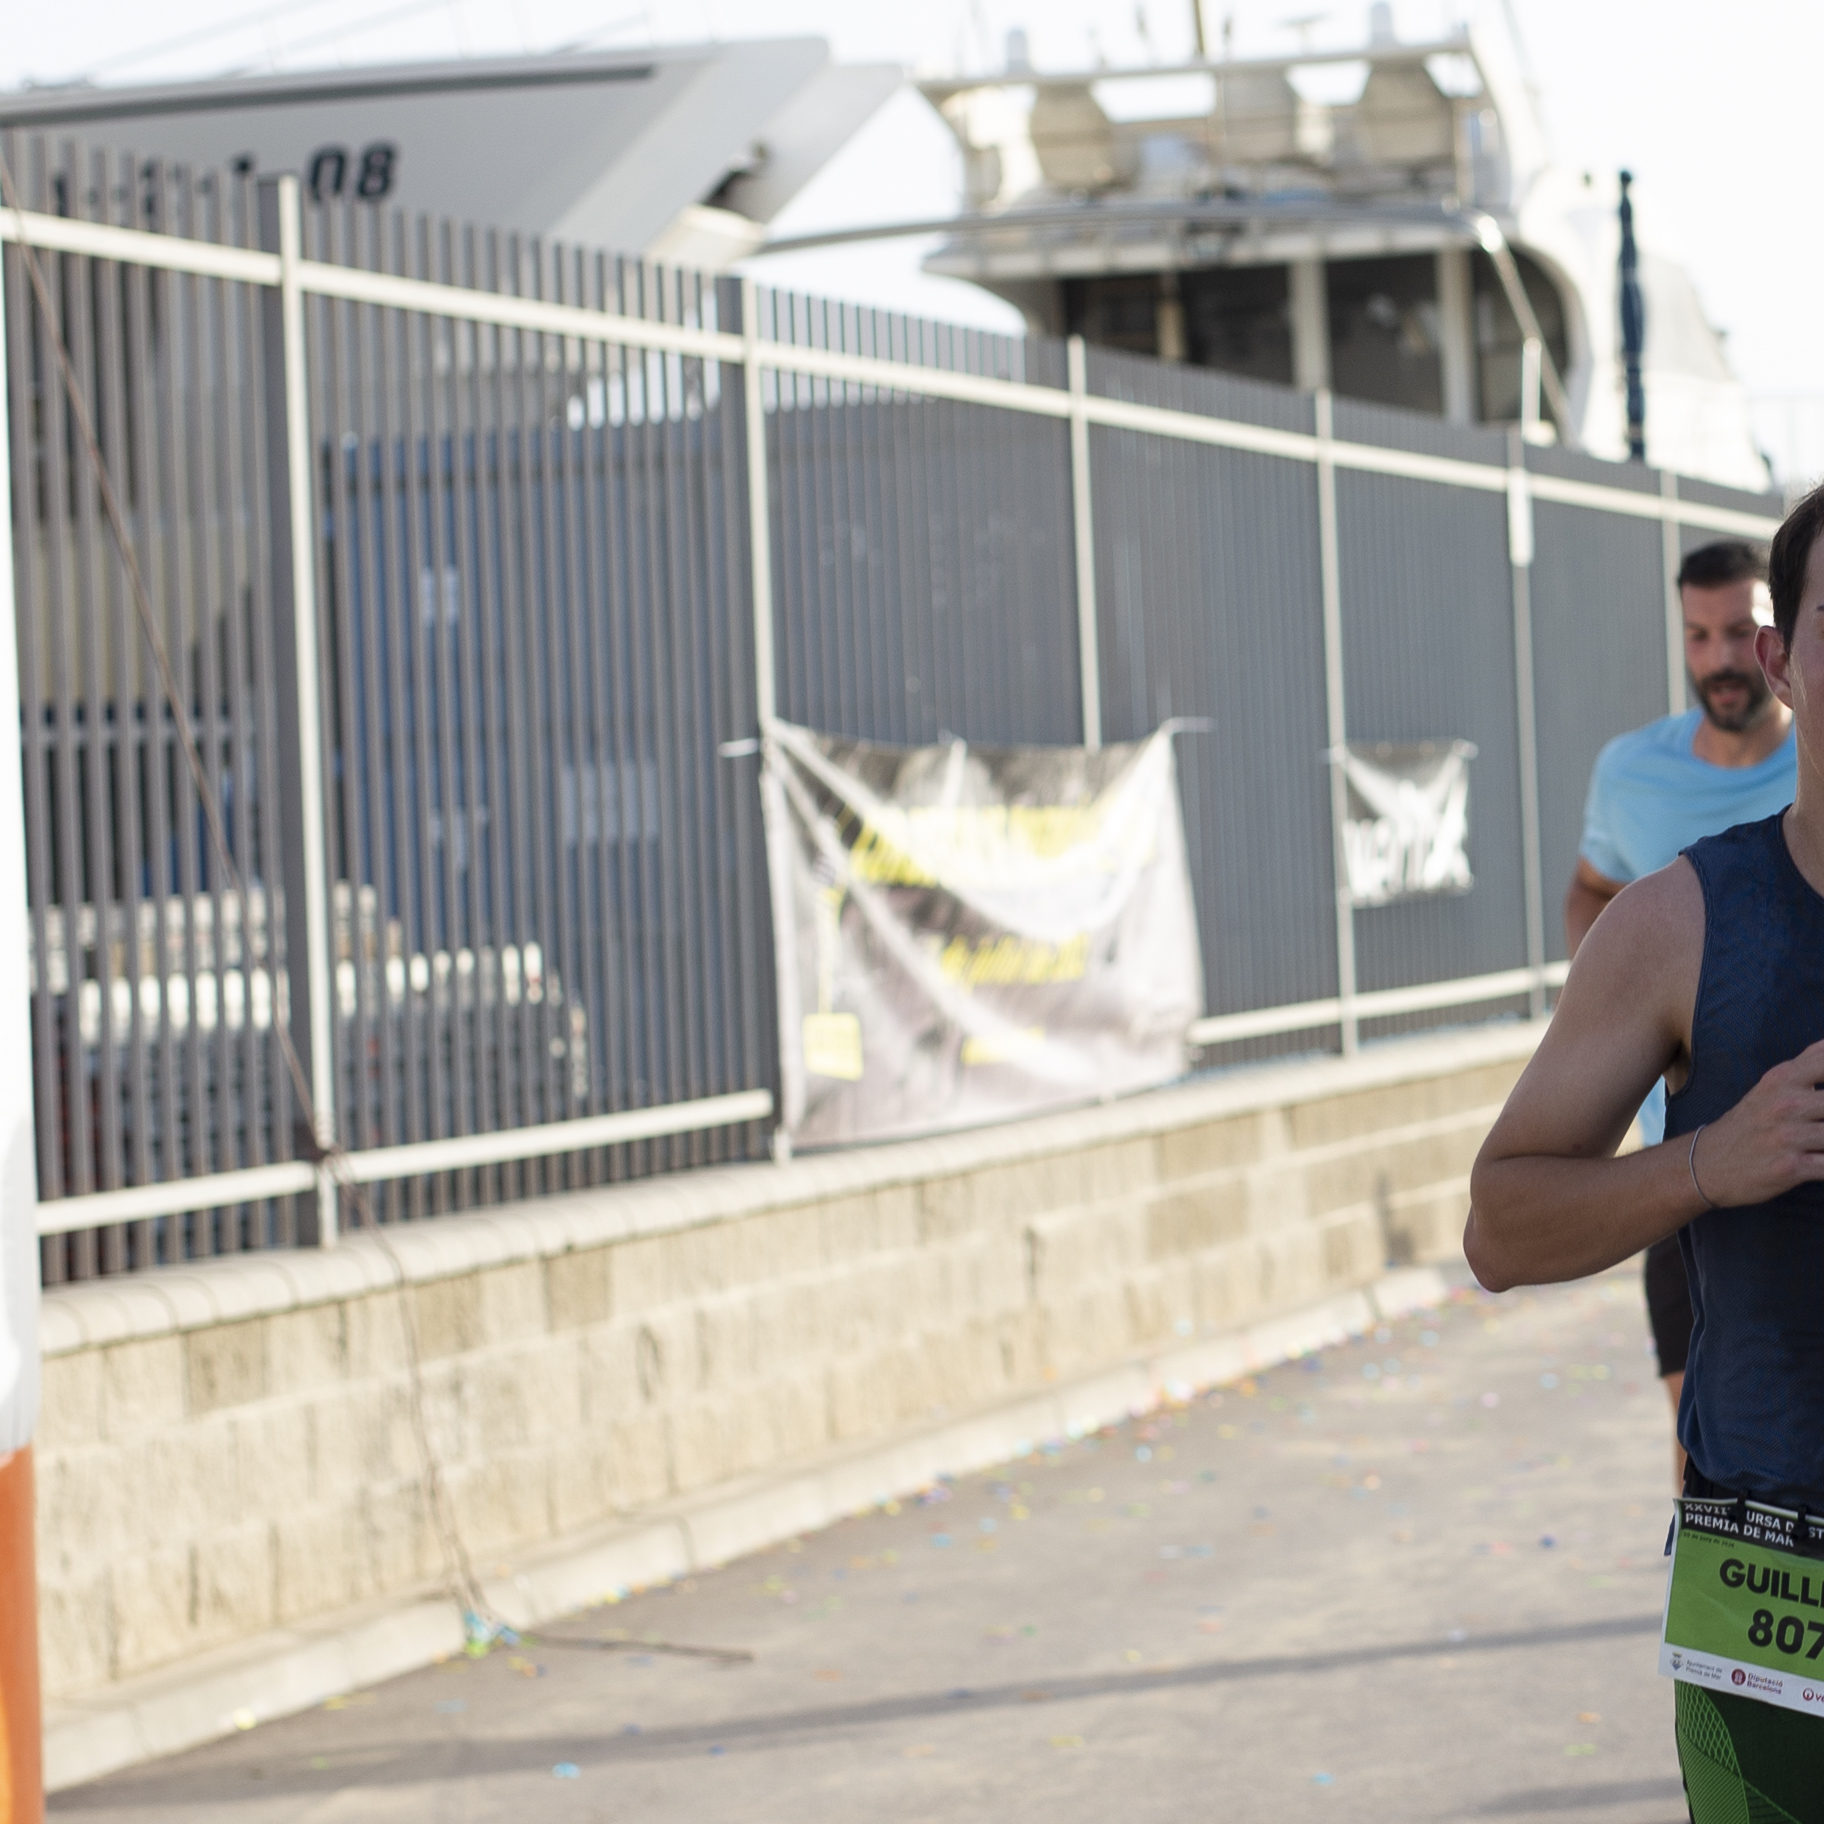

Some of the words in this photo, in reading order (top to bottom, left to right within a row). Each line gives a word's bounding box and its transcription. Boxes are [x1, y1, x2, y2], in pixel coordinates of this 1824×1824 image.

[1743, 1510, 1781, 1531] URSA
[1743, 1524, 1761, 1539] DE
[1747, 1681, 1782, 1694] Barcelona
[1748, 1672, 1783, 1688] Diputació
